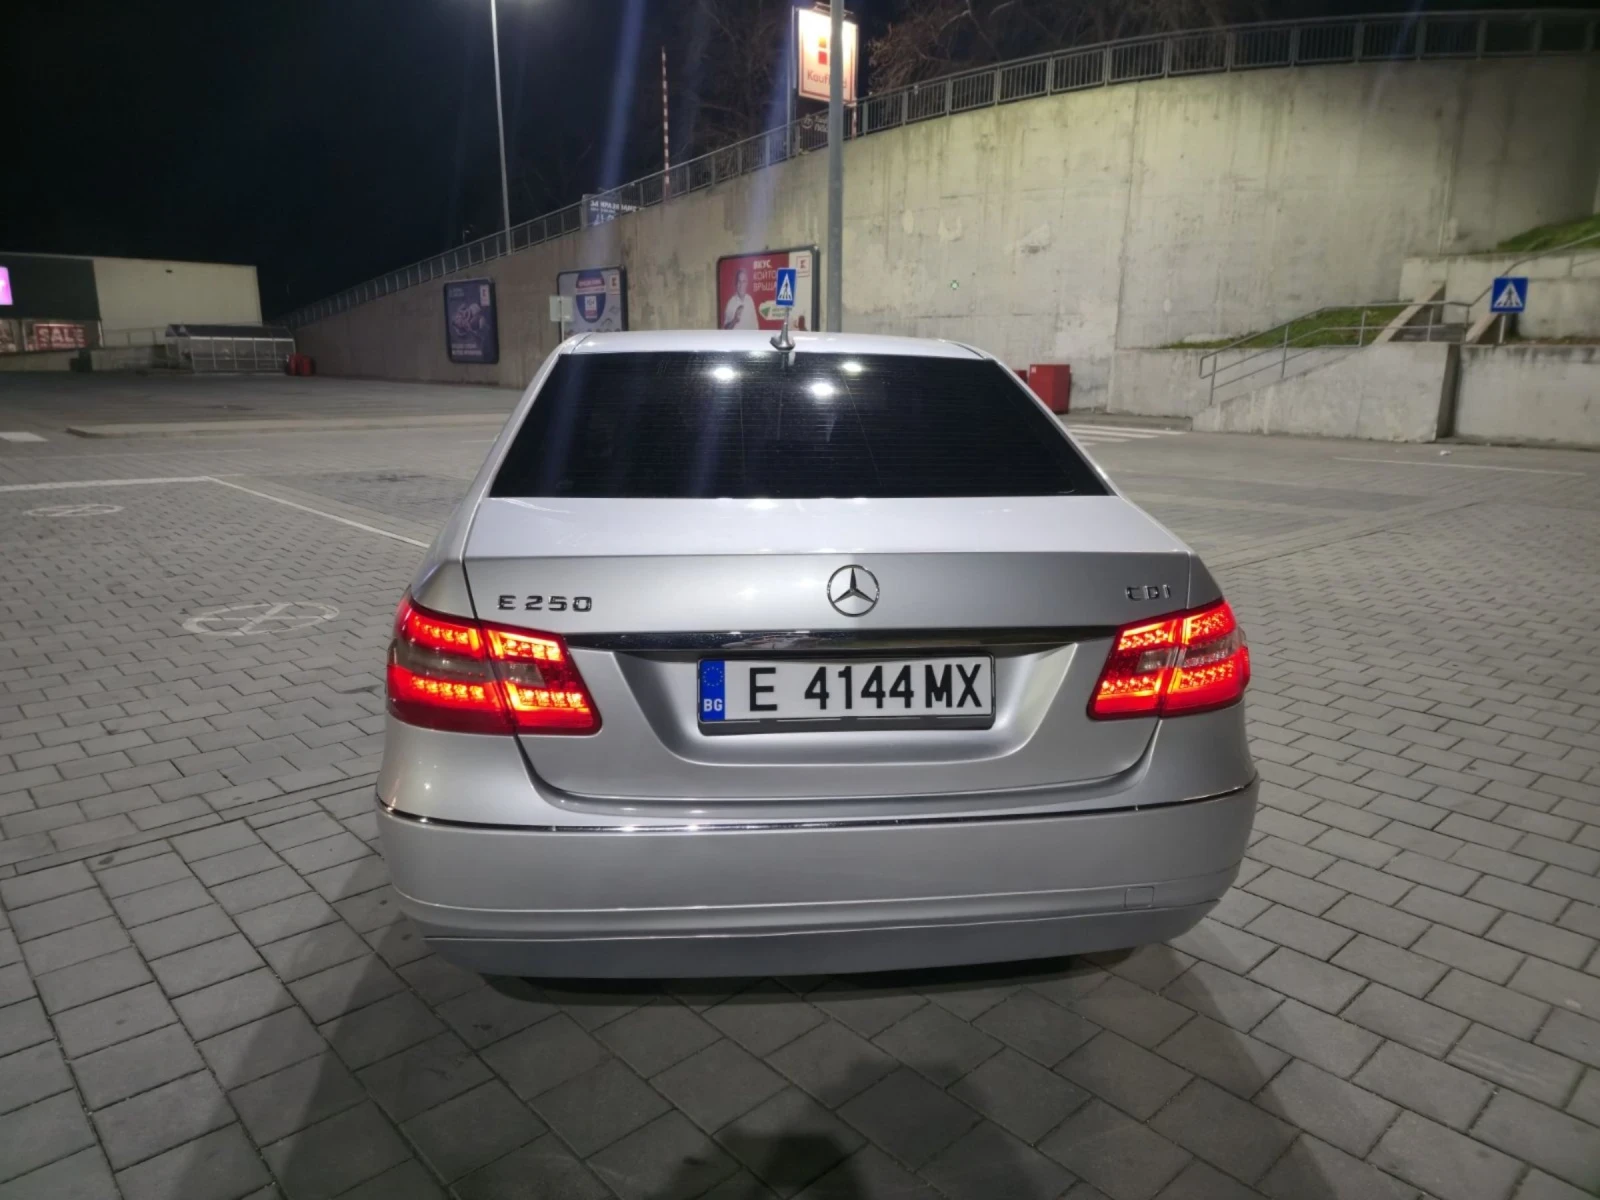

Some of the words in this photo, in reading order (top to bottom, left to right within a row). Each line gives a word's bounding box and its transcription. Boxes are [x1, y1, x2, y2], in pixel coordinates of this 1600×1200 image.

[39, 328, 84, 342] SALE
[1125, 584, 1171, 601] CDI
[498, 595, 516, 610] E
[525, 595, 592, 612] 250
[750, 667, 777, 711] E
[703, 699, 722, 711] BG
